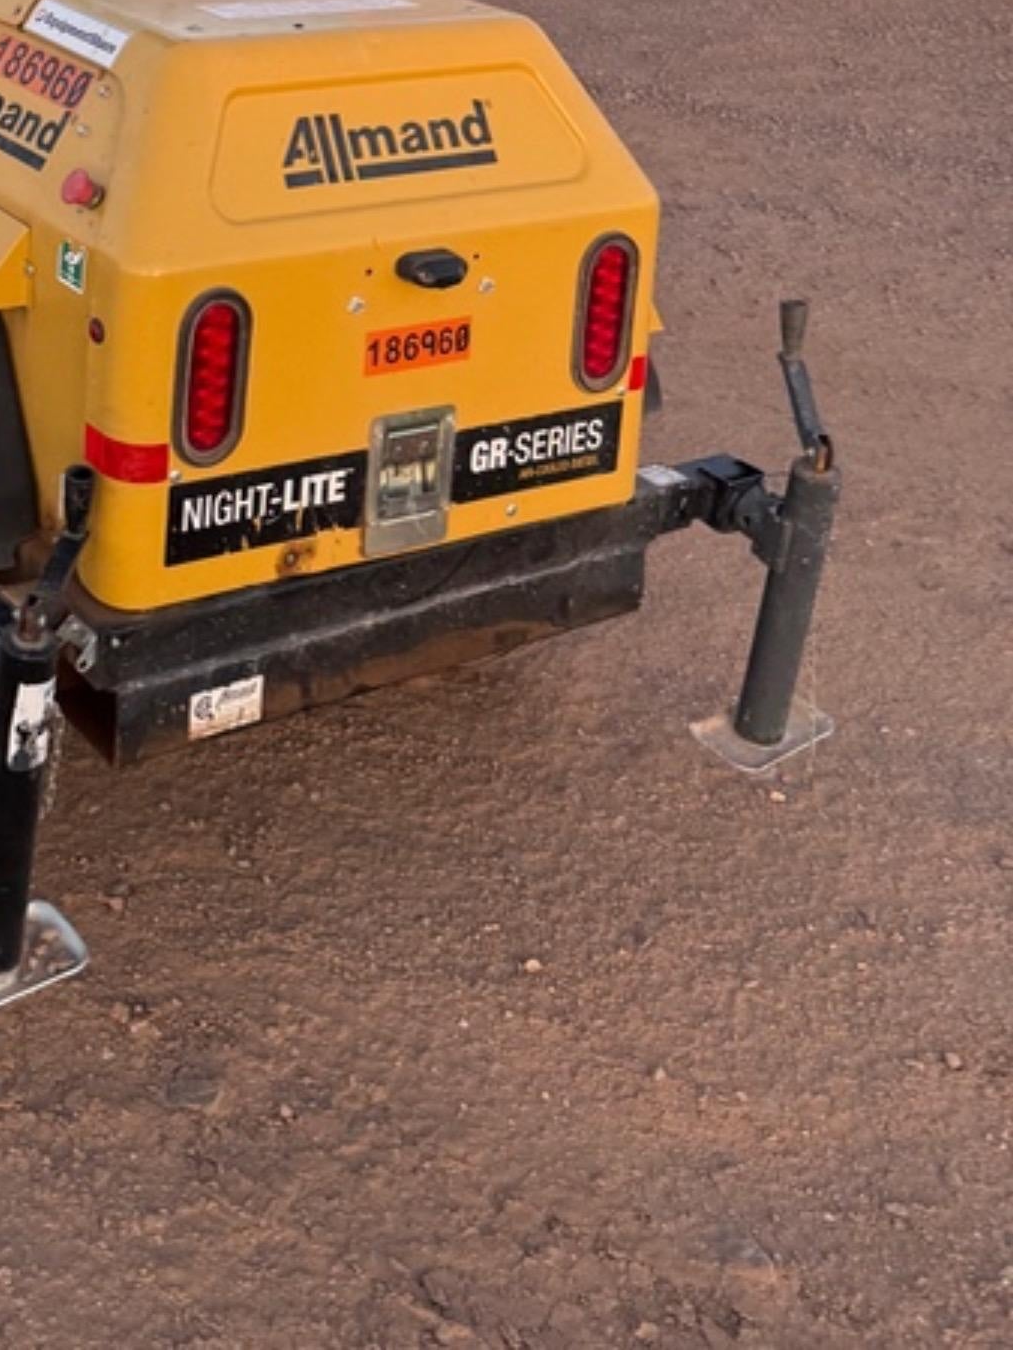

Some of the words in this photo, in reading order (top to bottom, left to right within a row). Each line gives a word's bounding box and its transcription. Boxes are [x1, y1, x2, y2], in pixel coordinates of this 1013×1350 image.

[283, 98, 493, 183] Allmand
[368, 323, 470, 367] 186960
[180, 470, 348, 533] NIGHT-LITE
[469, 418, 604, 474] GR-SERIES
